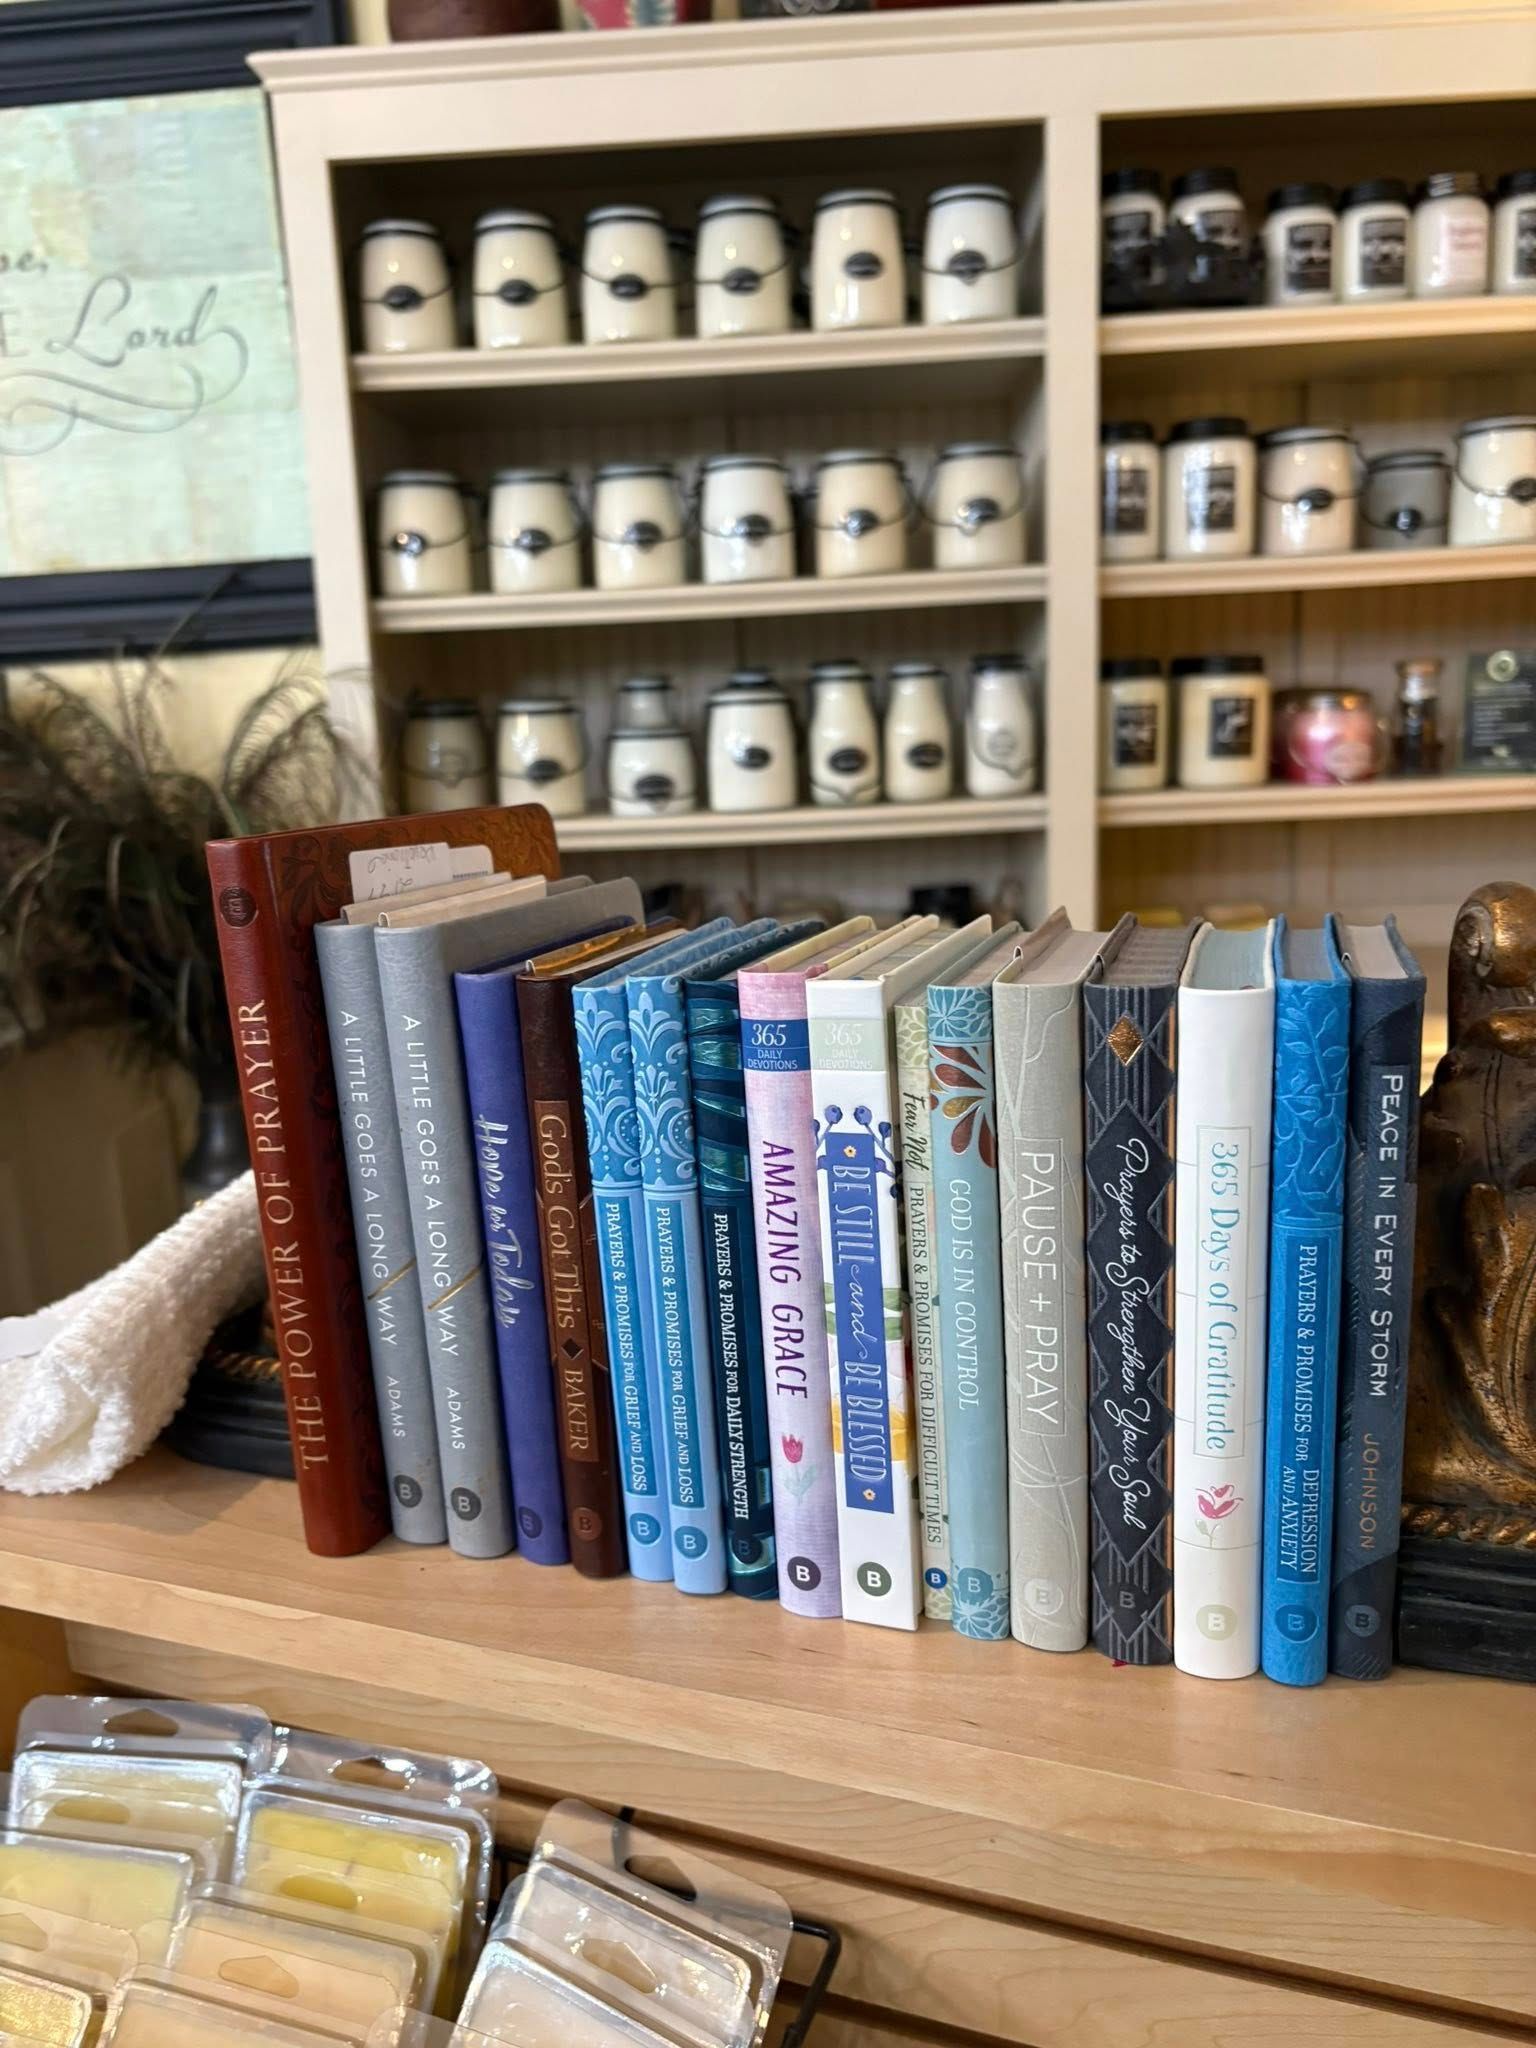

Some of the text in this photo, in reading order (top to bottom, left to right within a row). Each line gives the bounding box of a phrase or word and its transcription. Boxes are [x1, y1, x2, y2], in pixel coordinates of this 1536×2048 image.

[43, 273, 234, 370] Lord
[747, 1058, 798, 1070] DEVOTIONS
[751, 1023, 786, 1047] 365
[757, 1049, 782, 1059] DAILY
[818, 1058, 873, 1070] DEVOTIONS
[824, 1023, 863, 1047] 365
[832, 1048, 857, 1059] DAILY
[340, 1010, 398, 1346] A LITTLE GOES A LONG WAY
[902, 1092, 929, 1171] Fear Not
[402, 1014, 459, 1357] A LITTLE GOES A LONG WAY
[474, 1113, 535, 1329] Hope for Today
[539, 1113, 583, 1329] God's Got This
[238, 998, 329, 1471] THE POWER OF PRAYER
[762, 1140, 808, 1399] AMAZING GRACE
[1369, 1074, 1404, 1396] PEACE IN EVERY STORM
[832, 1164, 887, 1482] BE STILL and BE BLESSED
[949, 1179, 980, 1411] GOD IS IN CONTROL
[1021, 1152, 1059, 1424] PAUSE + PRAY
[1103, 1138, 1151, 1530] Prayers to Strengthen Your Soul
[1201, 1142, 1241, 1449] 365 Days of Gratitude
[606, 1202, 647, 1491] PRAYERS & PROMISES FOR GRIEF AND LOSS
[656, 1207, 694, 1504] PRAYERS & PROMISES FOR GRIEF AND LOSS
[714, 1213, 749, 1520] PRAYERS & PROMISES FOR DAILY STRENGTH
[910, 1187, 942, 1543] PRAYERS & PROMISES FOR DIFFICULT TIMES
[1294, 1244, 1317, 1461] PRAYERS & PROMISES FOR
[386, 1375, 406, 1438] ADAMS
[446, 1386, 466, 1450] ADAMS
[564, 1368, 588, 1450] BAKER
[457, 1495, 471, 1513] B
[636, 1520, 649, 1536] B
[1280, 1465, 1298, 1570] AND ANXIETY
[1301, 1469, 1320, 1573] DEPRESSION
[1360, 1433, 1380, 1549] JOHNSON
[683, 1534, 697, 1550] B
[795, 1565, 810, 1582] B
[866, 1570, 882, 1588] B
[931, 1573, 941, 1584] B
[967, 1577, 981, 1593] B
[1119, 1590, 1136, 1608] B
[1207, 1612, 1225, 1631] B
[1355, 1612, 1370, 1628] B
